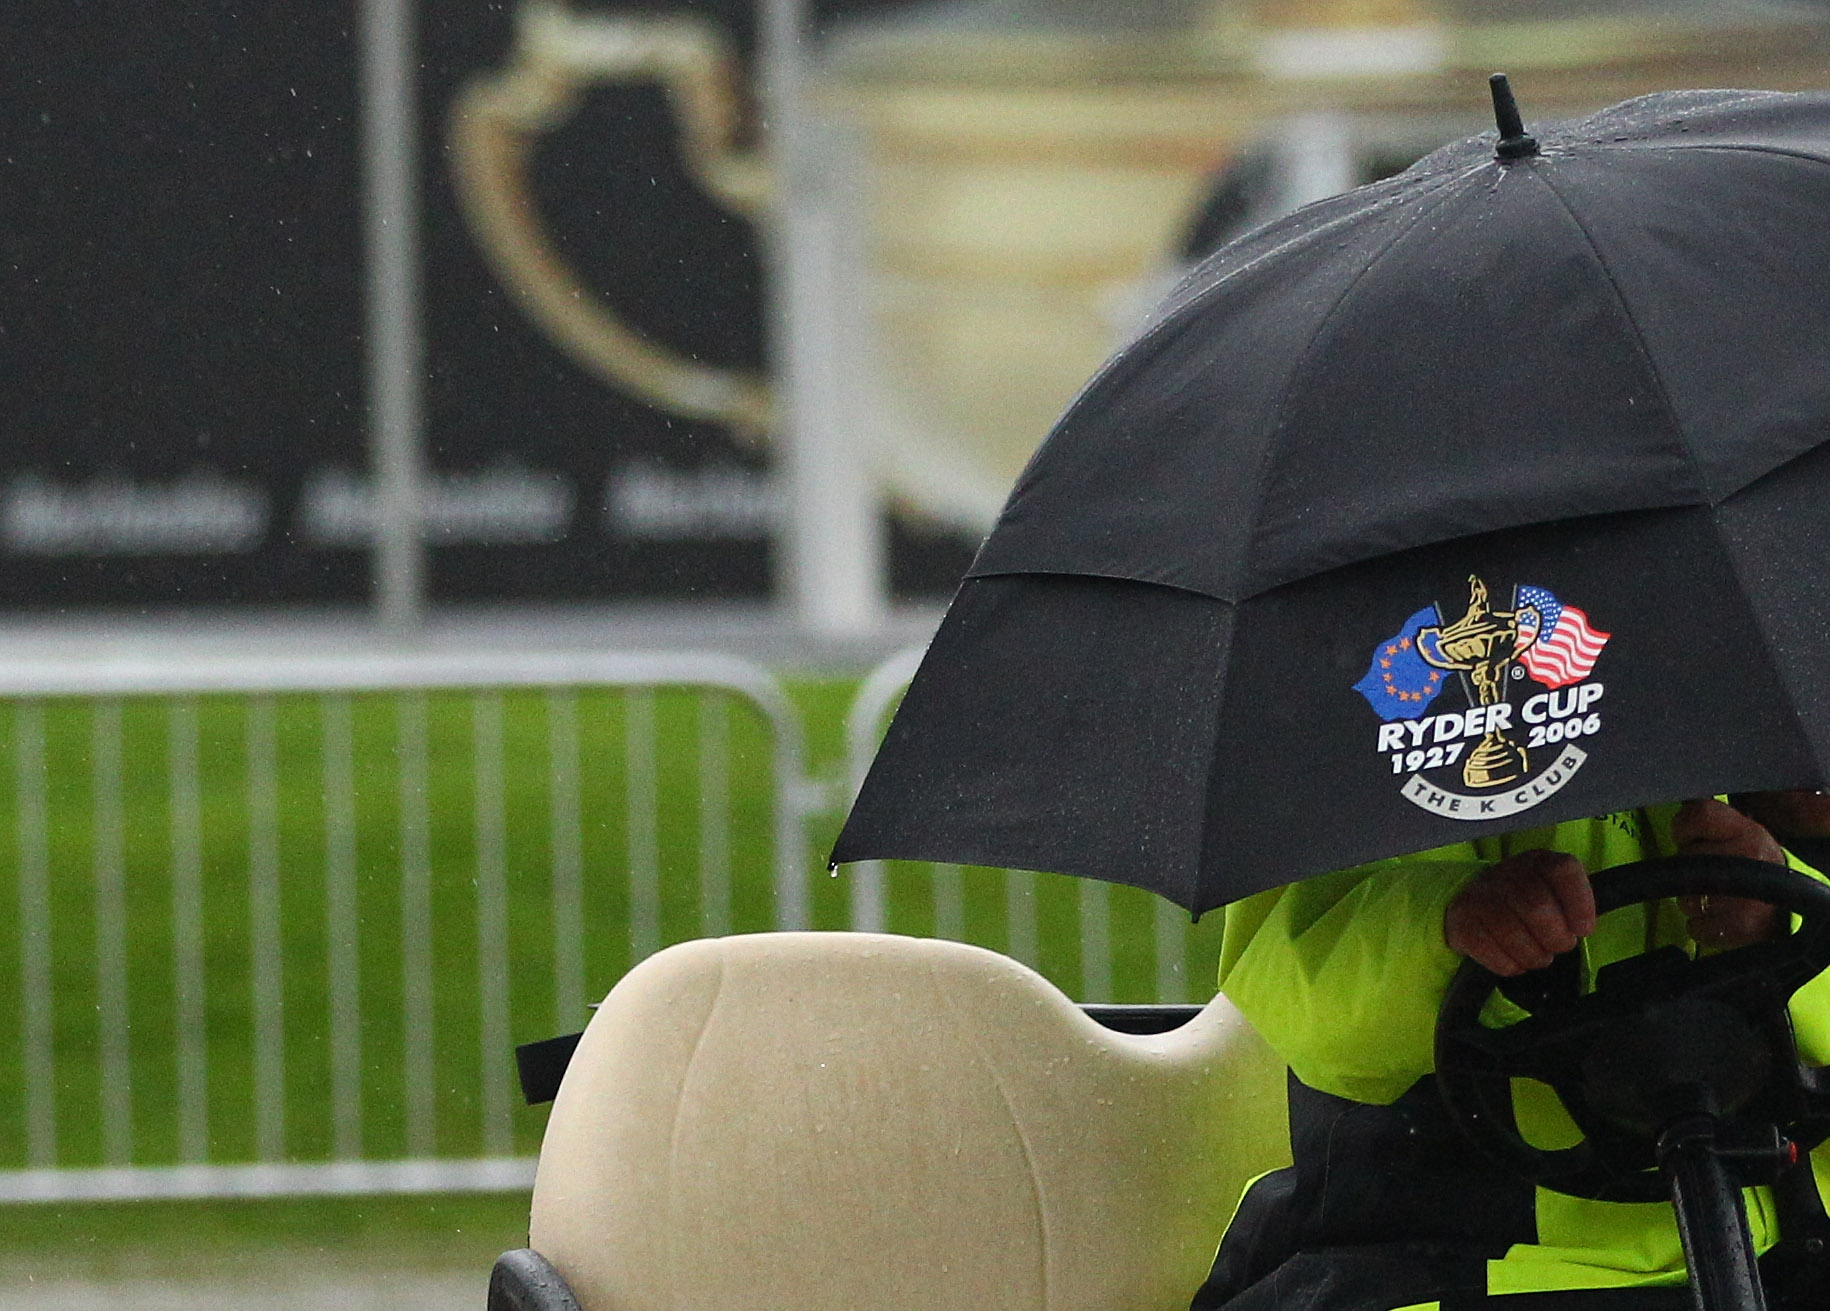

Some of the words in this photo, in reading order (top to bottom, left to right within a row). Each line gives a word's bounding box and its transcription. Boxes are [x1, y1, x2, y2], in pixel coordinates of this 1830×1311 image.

[1377, 703, 1512, 752] RYDER
[1521, 683, 1604, 724] CUP
[1391, 742, 1465, 774] 1927
[1526, 713, 1601, 749] 2006
[1413, 783, 1460, 812] THE
[1480, 800, 1495, 813] K
[1514, 755, 1577, 804] CLUB
